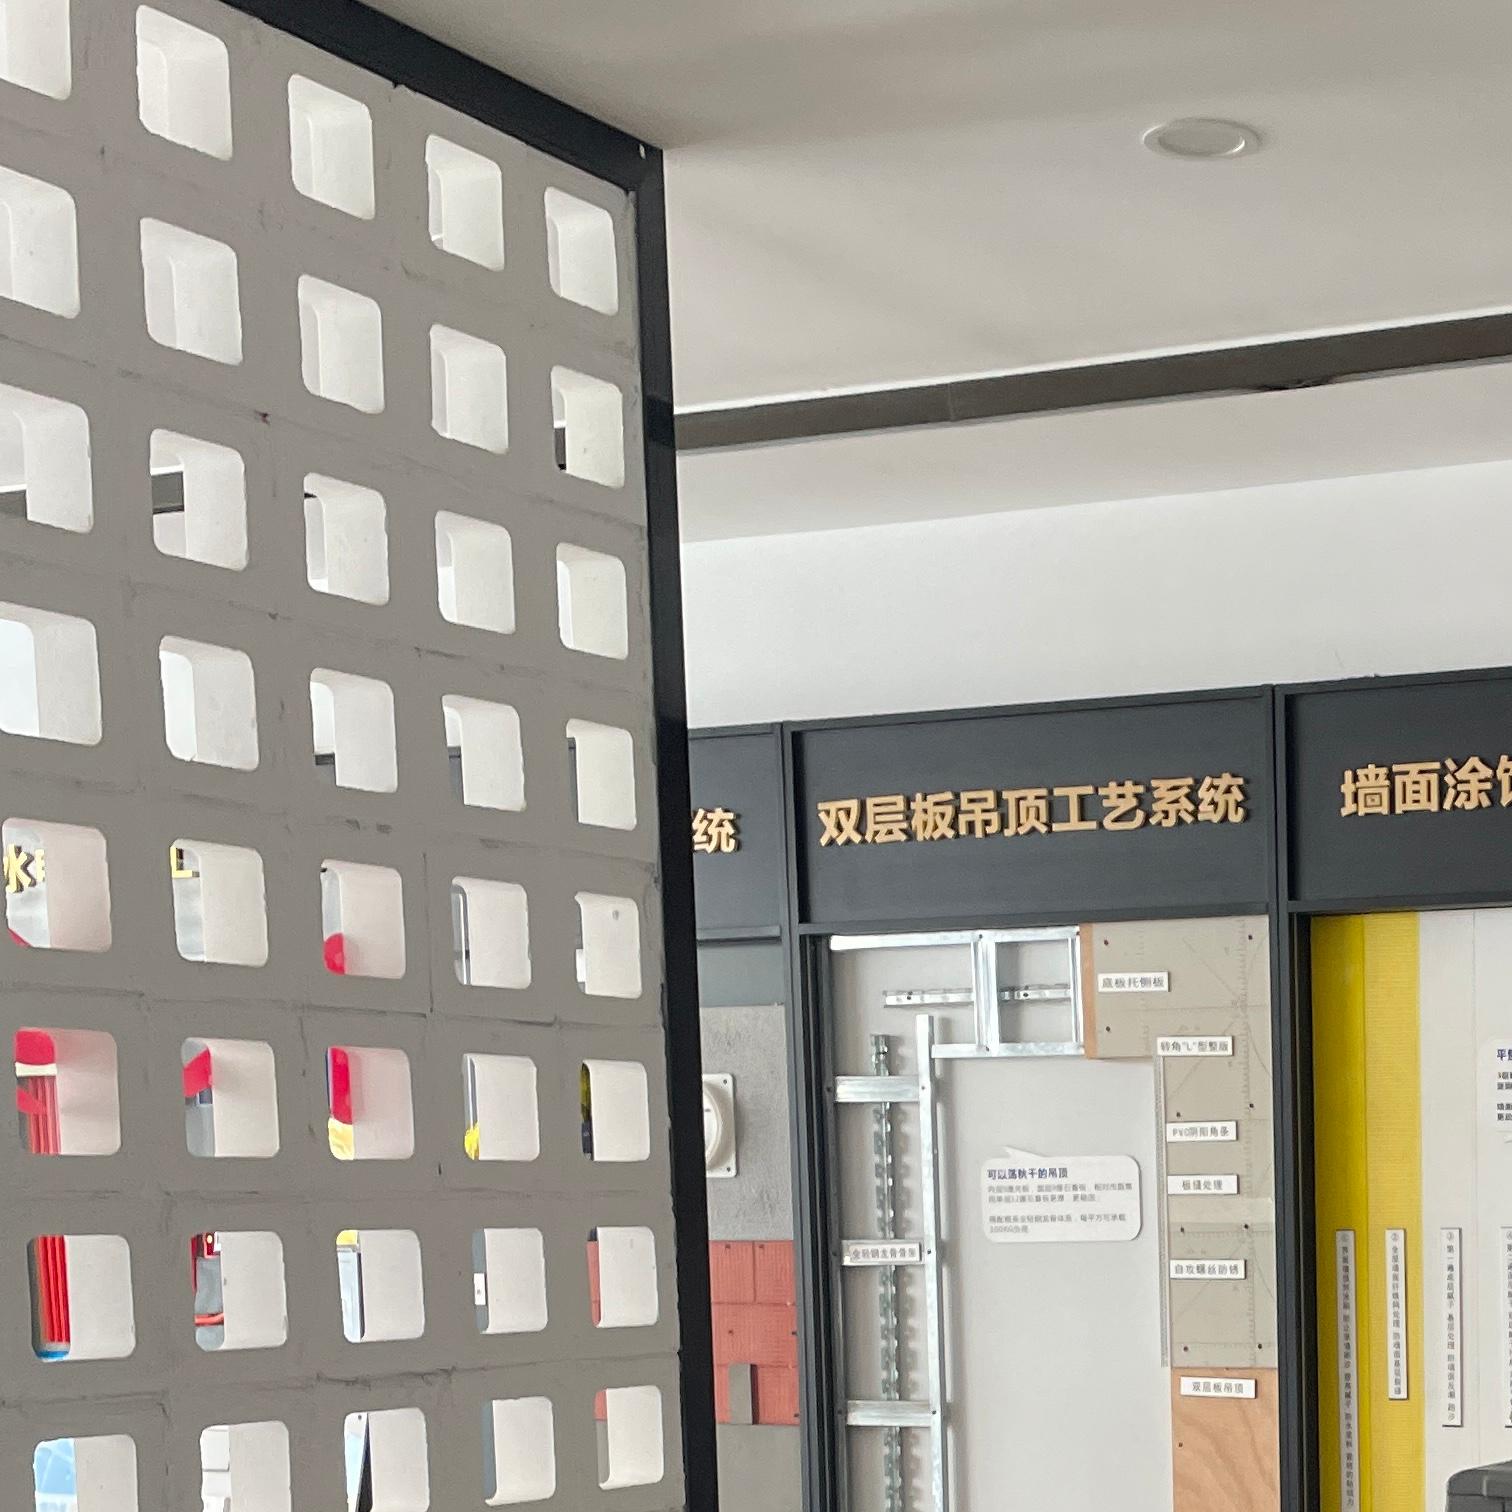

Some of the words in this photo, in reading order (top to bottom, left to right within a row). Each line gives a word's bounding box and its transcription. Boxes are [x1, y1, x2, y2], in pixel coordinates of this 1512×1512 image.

[816, 772, 1246, 848] 双层板吊顶工艺系统
[1173, 1262, 1239, 1275] 自攻螺丝防锈
[1191, 1381, 1244, 1395] 双层板吊顶
